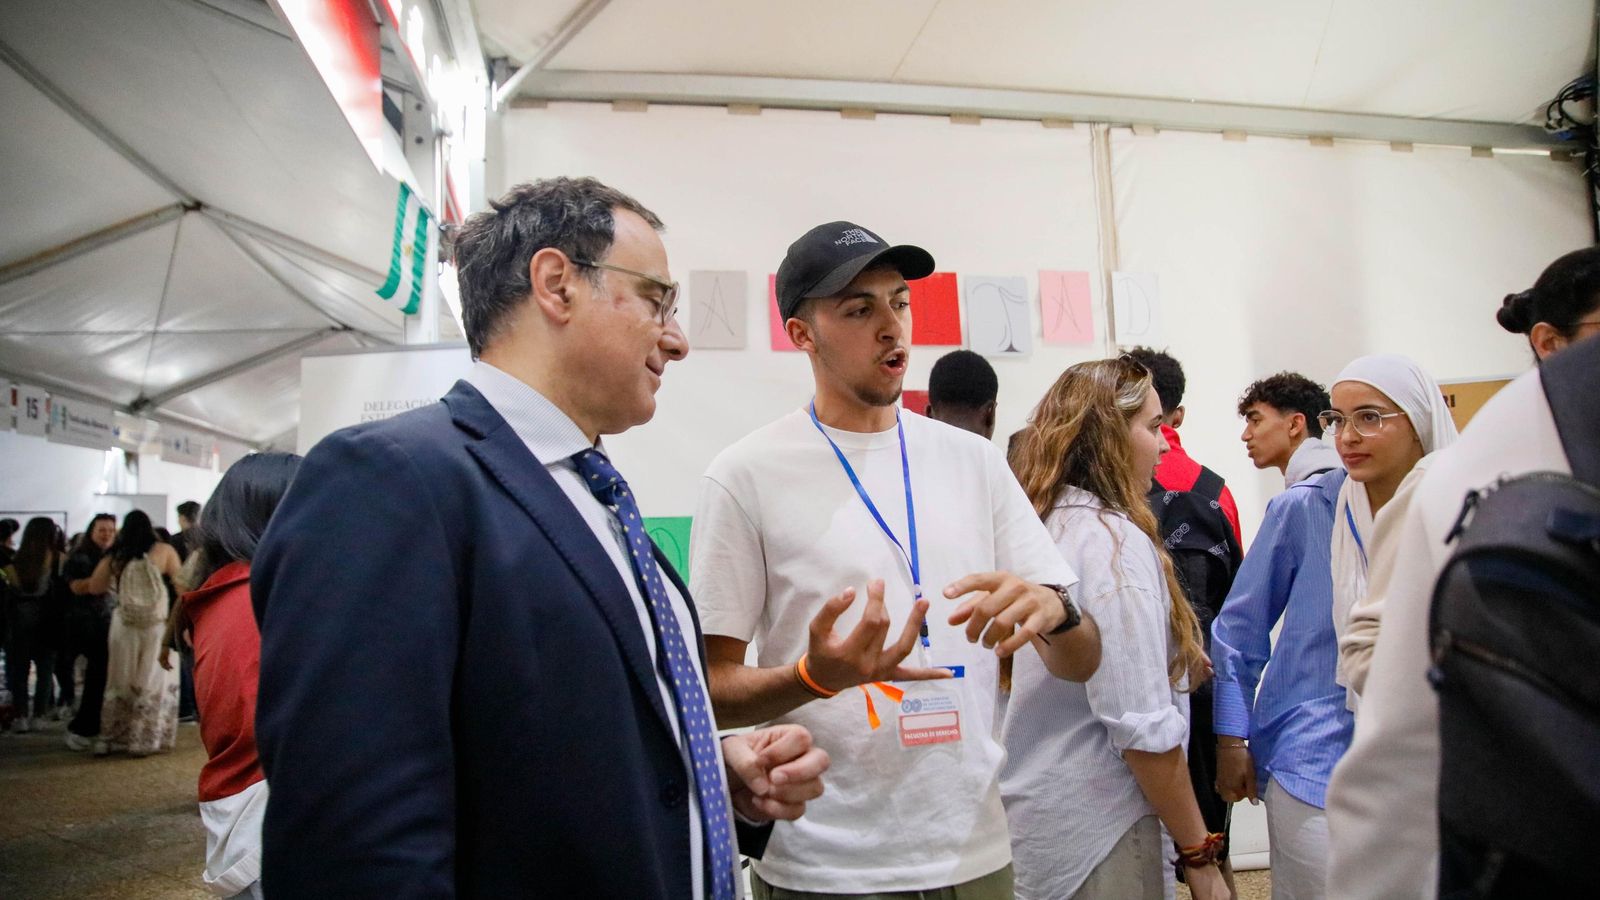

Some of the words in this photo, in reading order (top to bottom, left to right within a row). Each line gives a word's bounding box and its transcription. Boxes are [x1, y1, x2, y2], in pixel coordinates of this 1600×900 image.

[26, 397, 39, 419] 15
[904, 731, 928, 740] FACULTAD
[928, 730, 936, 738] DE
[935, 728, 959, 737] DERECHO
